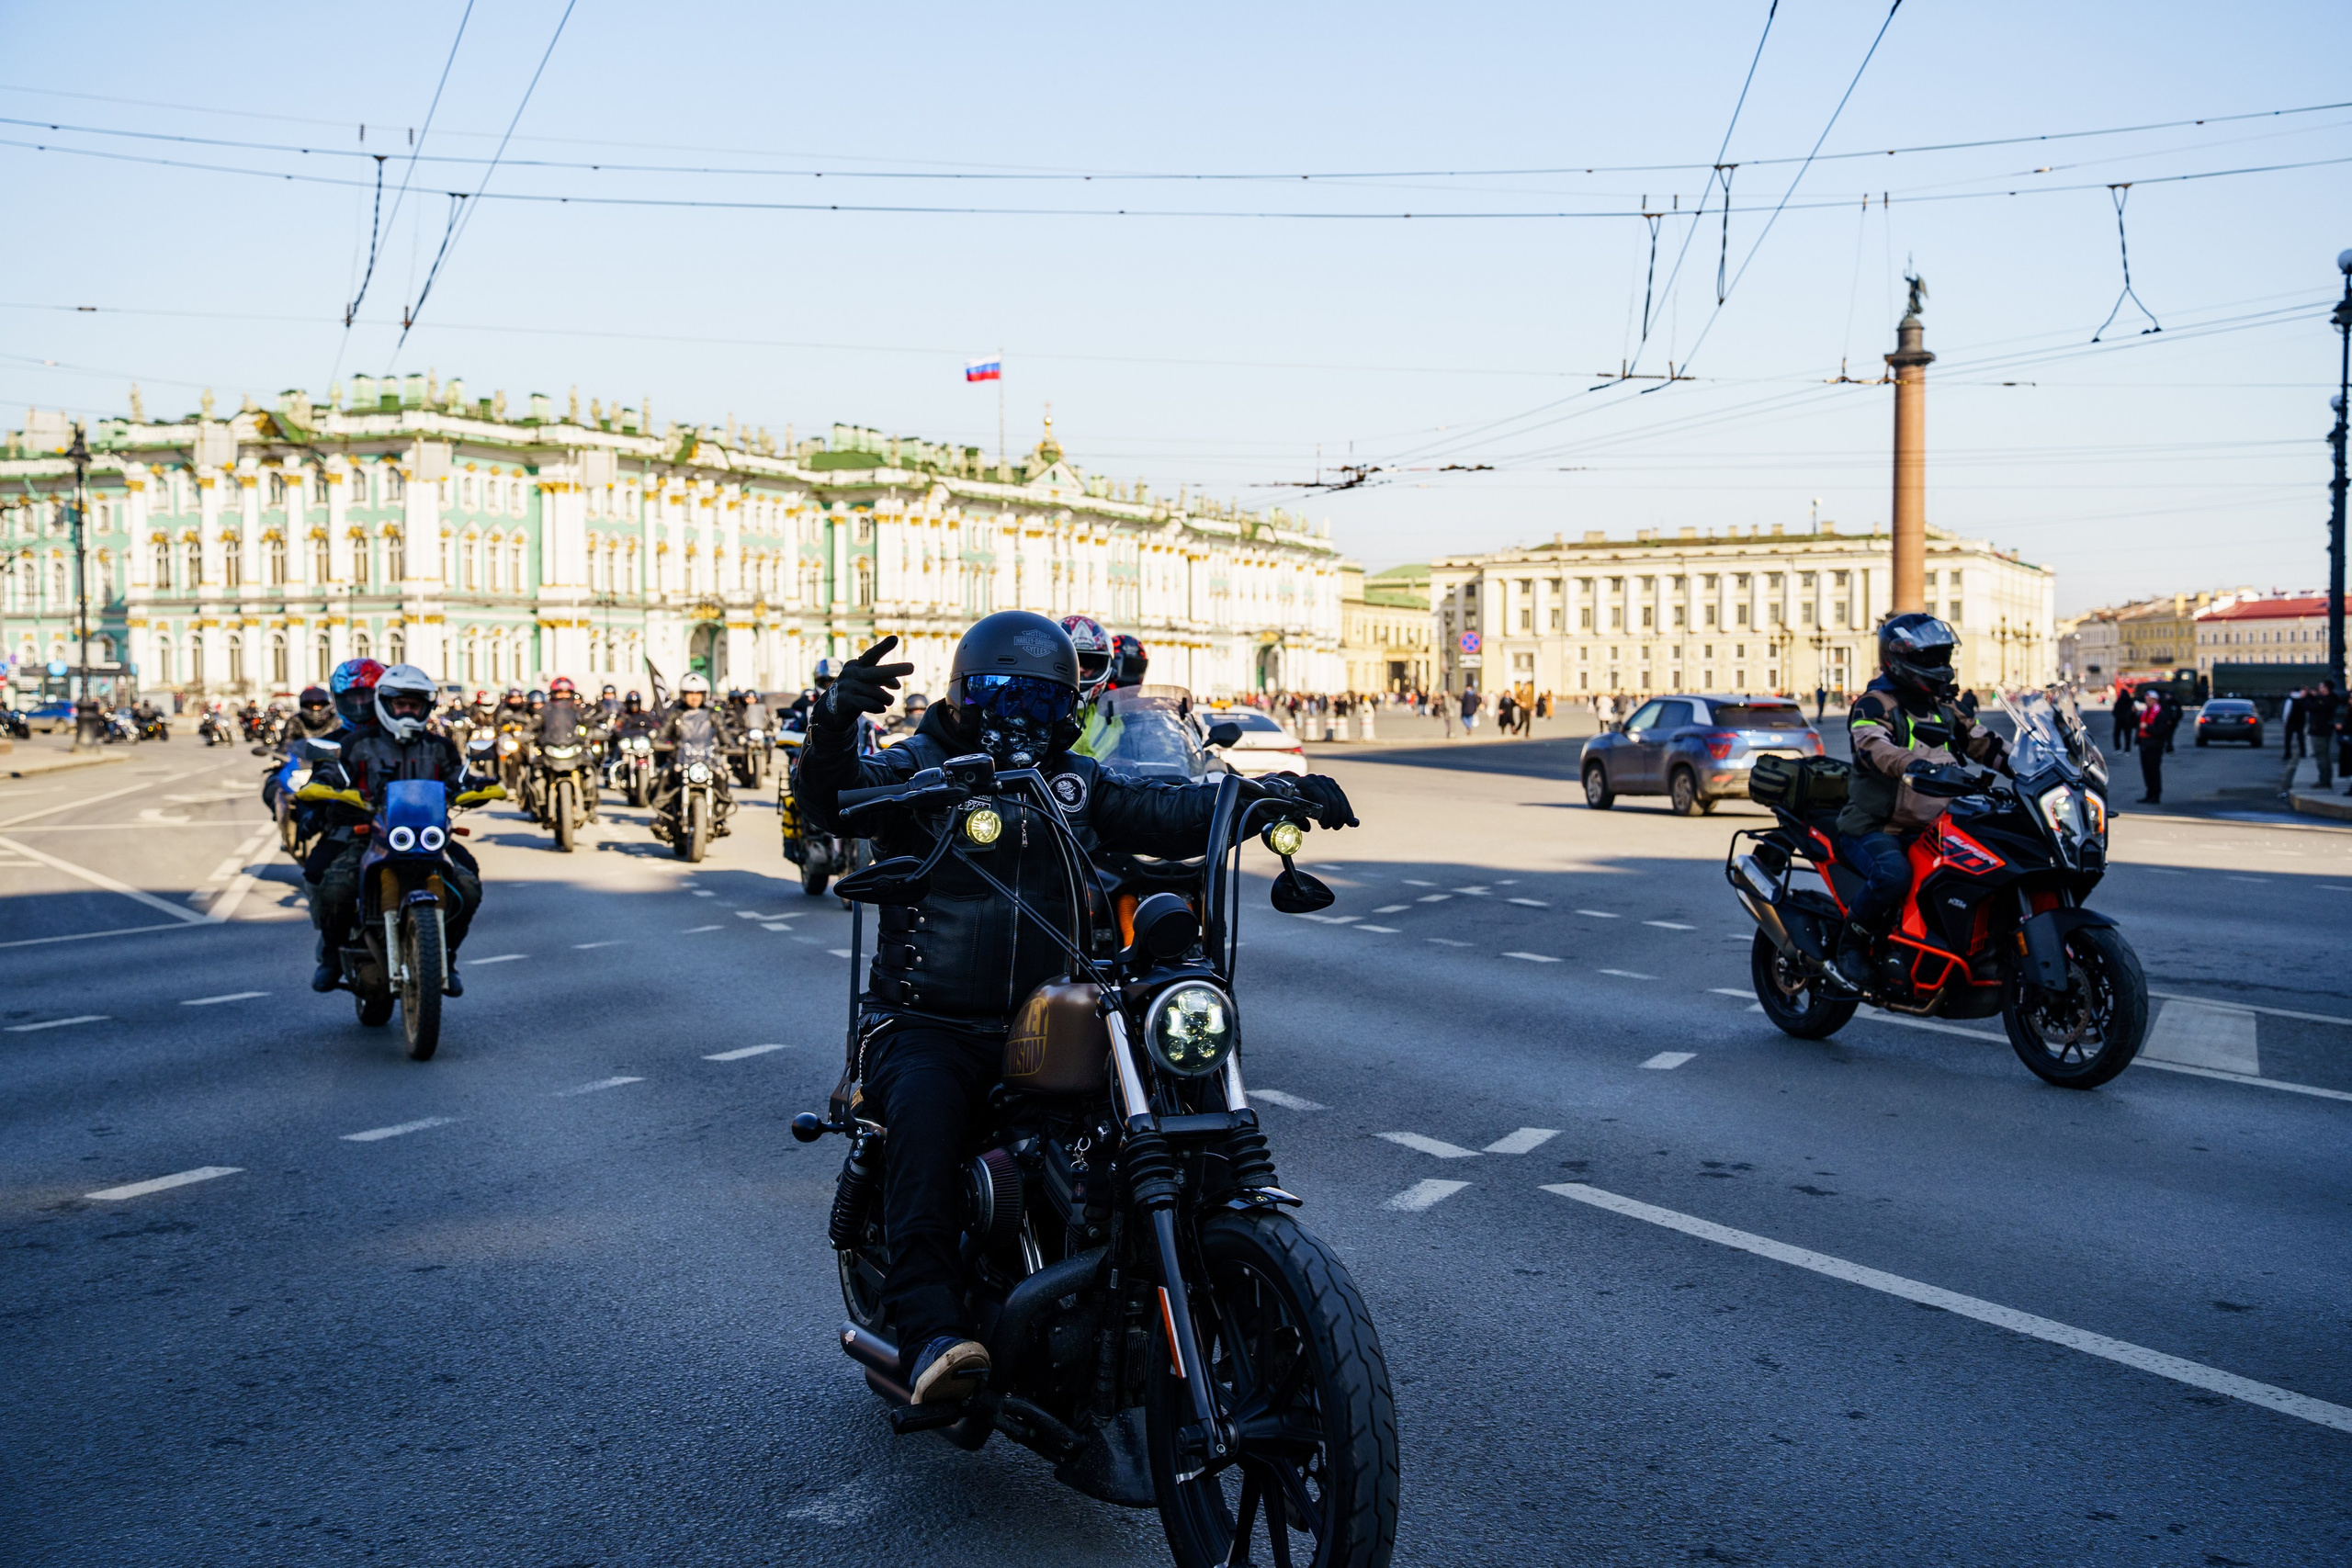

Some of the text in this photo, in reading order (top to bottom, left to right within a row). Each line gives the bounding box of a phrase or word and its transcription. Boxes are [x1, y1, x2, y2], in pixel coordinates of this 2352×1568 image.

[1025, 631, 1048, 639] MOTOR
[1015, 637, 1057, 649] HARLEY-DAVIDSON
[1025, 646, 1048, 655] CYCLES
[1946, 836, 1998, 865] SUPER
